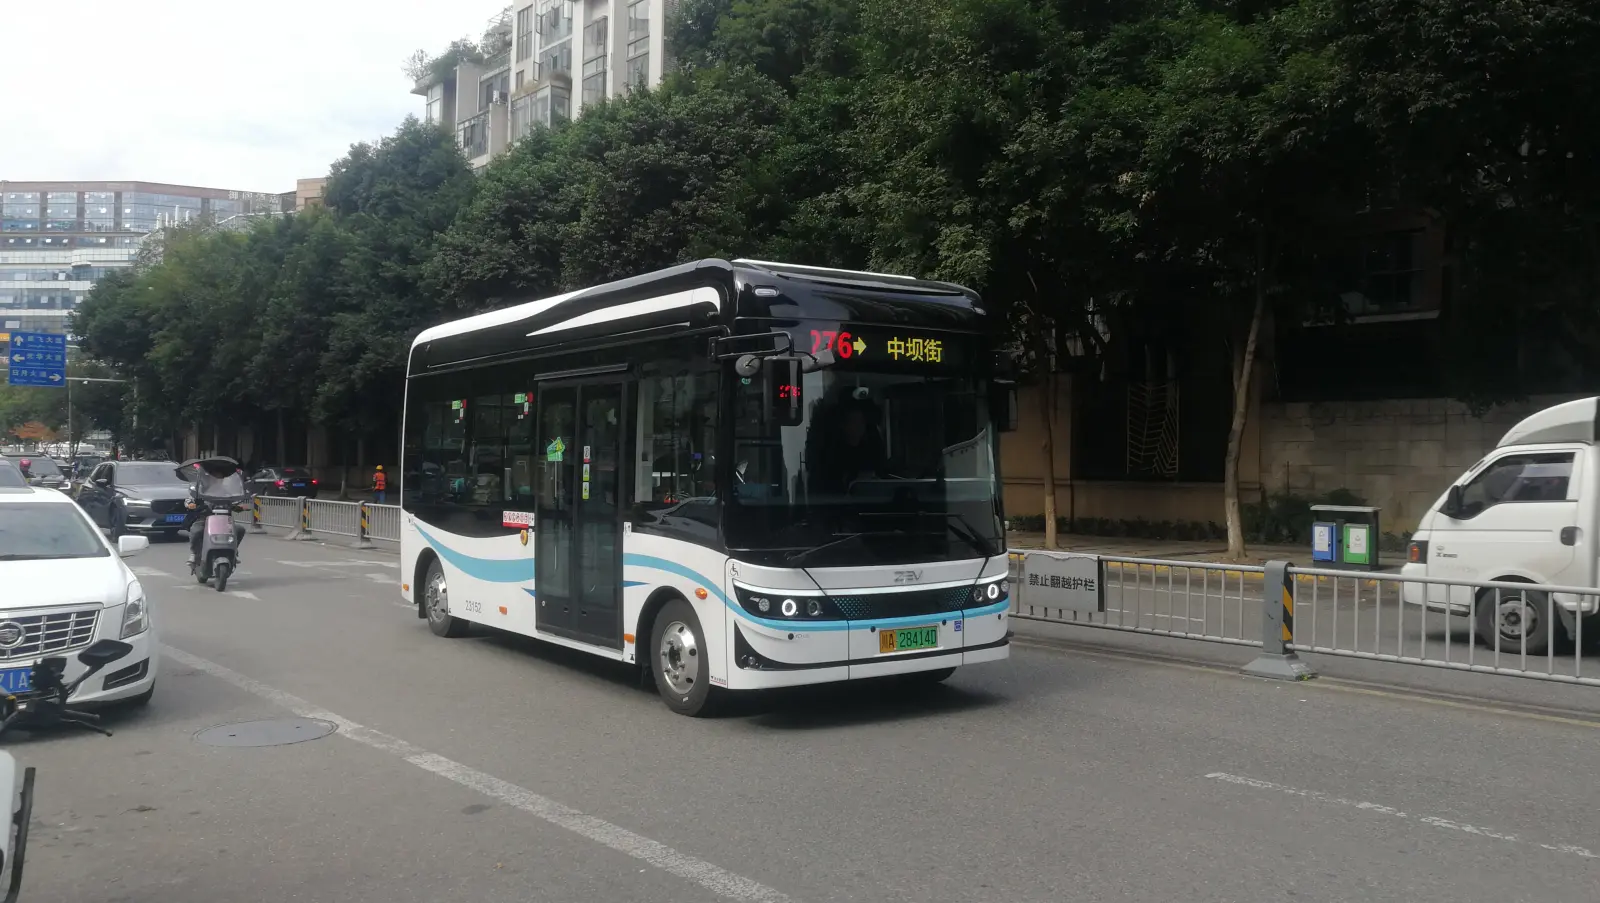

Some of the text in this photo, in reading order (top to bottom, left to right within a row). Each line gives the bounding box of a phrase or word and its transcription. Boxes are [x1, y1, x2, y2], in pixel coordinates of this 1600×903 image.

[887, 337, 943, 363] 中坝街
[1029, 573, 1095, 591] 禁止翻越护栏
[465, 599, 482, 614] 23152
